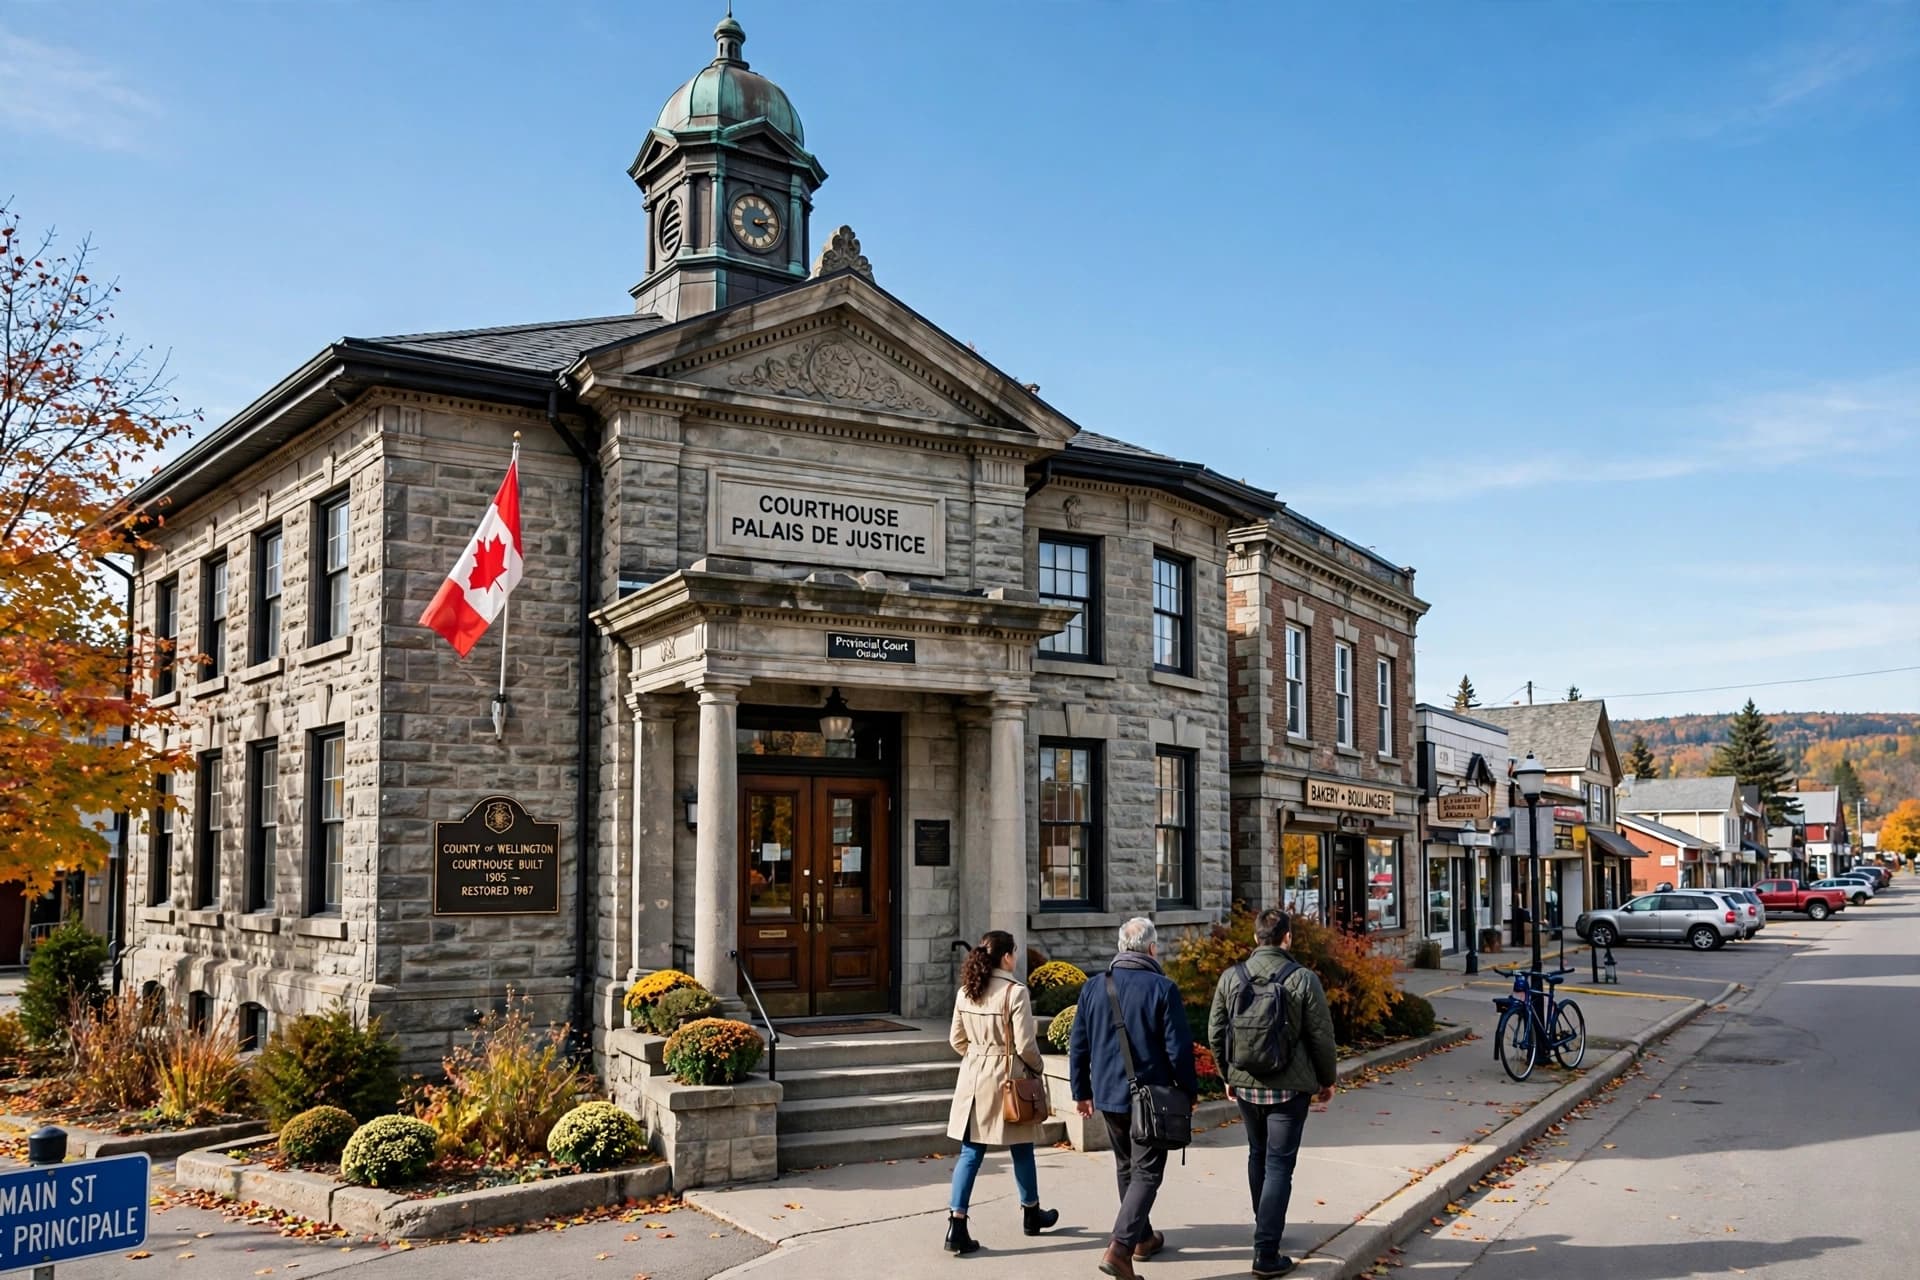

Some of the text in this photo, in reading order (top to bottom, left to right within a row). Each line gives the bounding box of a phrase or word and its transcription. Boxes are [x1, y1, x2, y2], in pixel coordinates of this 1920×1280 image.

[759, 495, 899, 528] COURTHOUSE
[732, 517, 926, 554] PALAIS DE JUSTICE
[836, 636, 909, 651] Provincial Court
[1311, 785, 1339, 804] BAKERY
[443, 844, 480, 854] COUNTY
[497, 844, 553, 854] WELLINGTON
[452, 860, 544, 870] COURTHOUSE BUILT
[485, 873, 507, 883] 1905
[461, 886, 534, 896] RESTORED 1987
[0, 1174, 97, 1217] MAIN ST
[13, 1206, 139, 1256] PRINCIPALE
